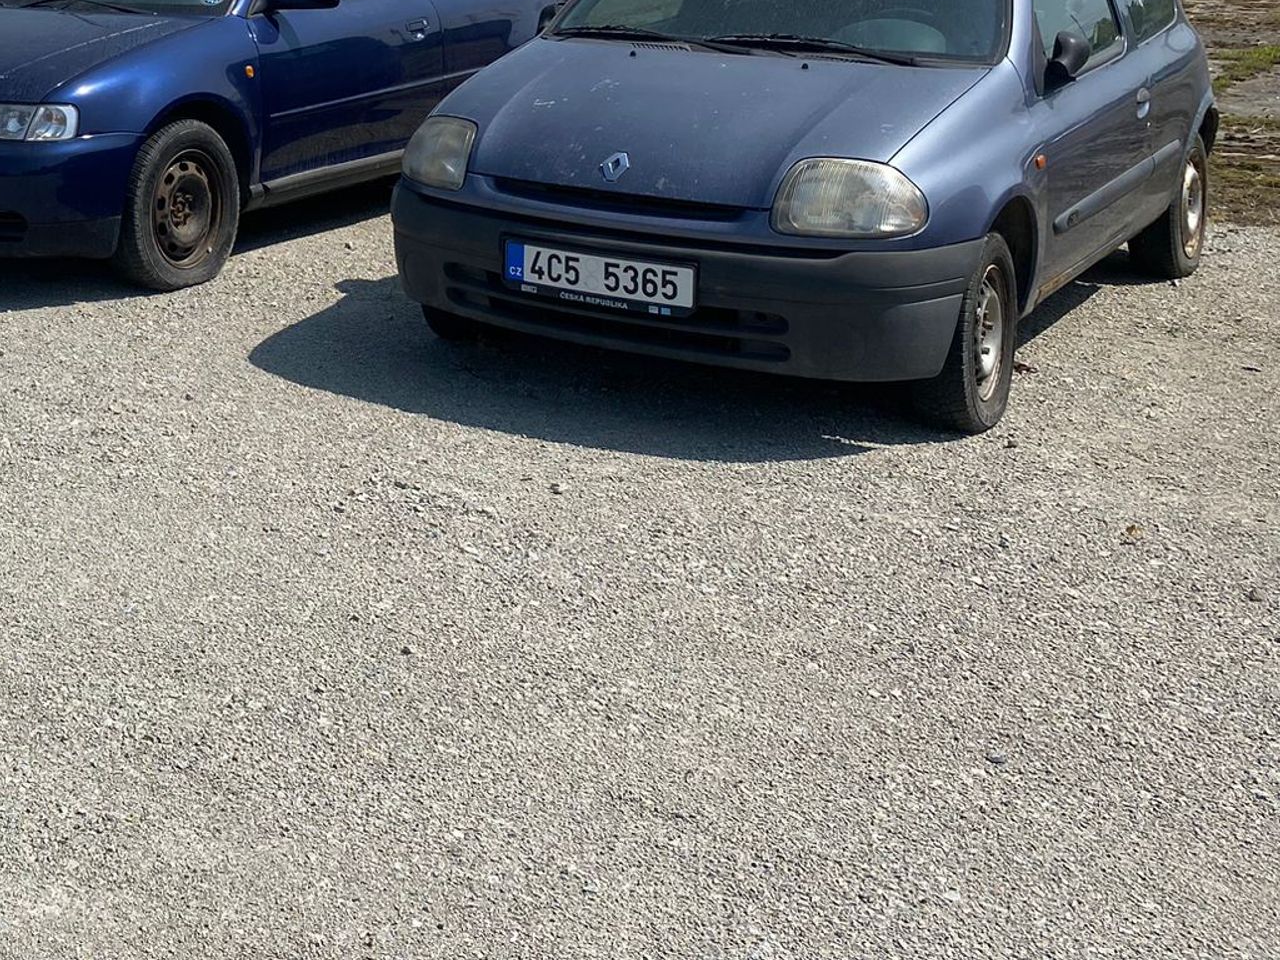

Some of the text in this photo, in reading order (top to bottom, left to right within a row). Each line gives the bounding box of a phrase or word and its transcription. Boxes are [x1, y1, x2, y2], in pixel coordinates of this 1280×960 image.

[509, 266, 522, 277] CZ
[530, 250, 679, 300] 4C5 5365
